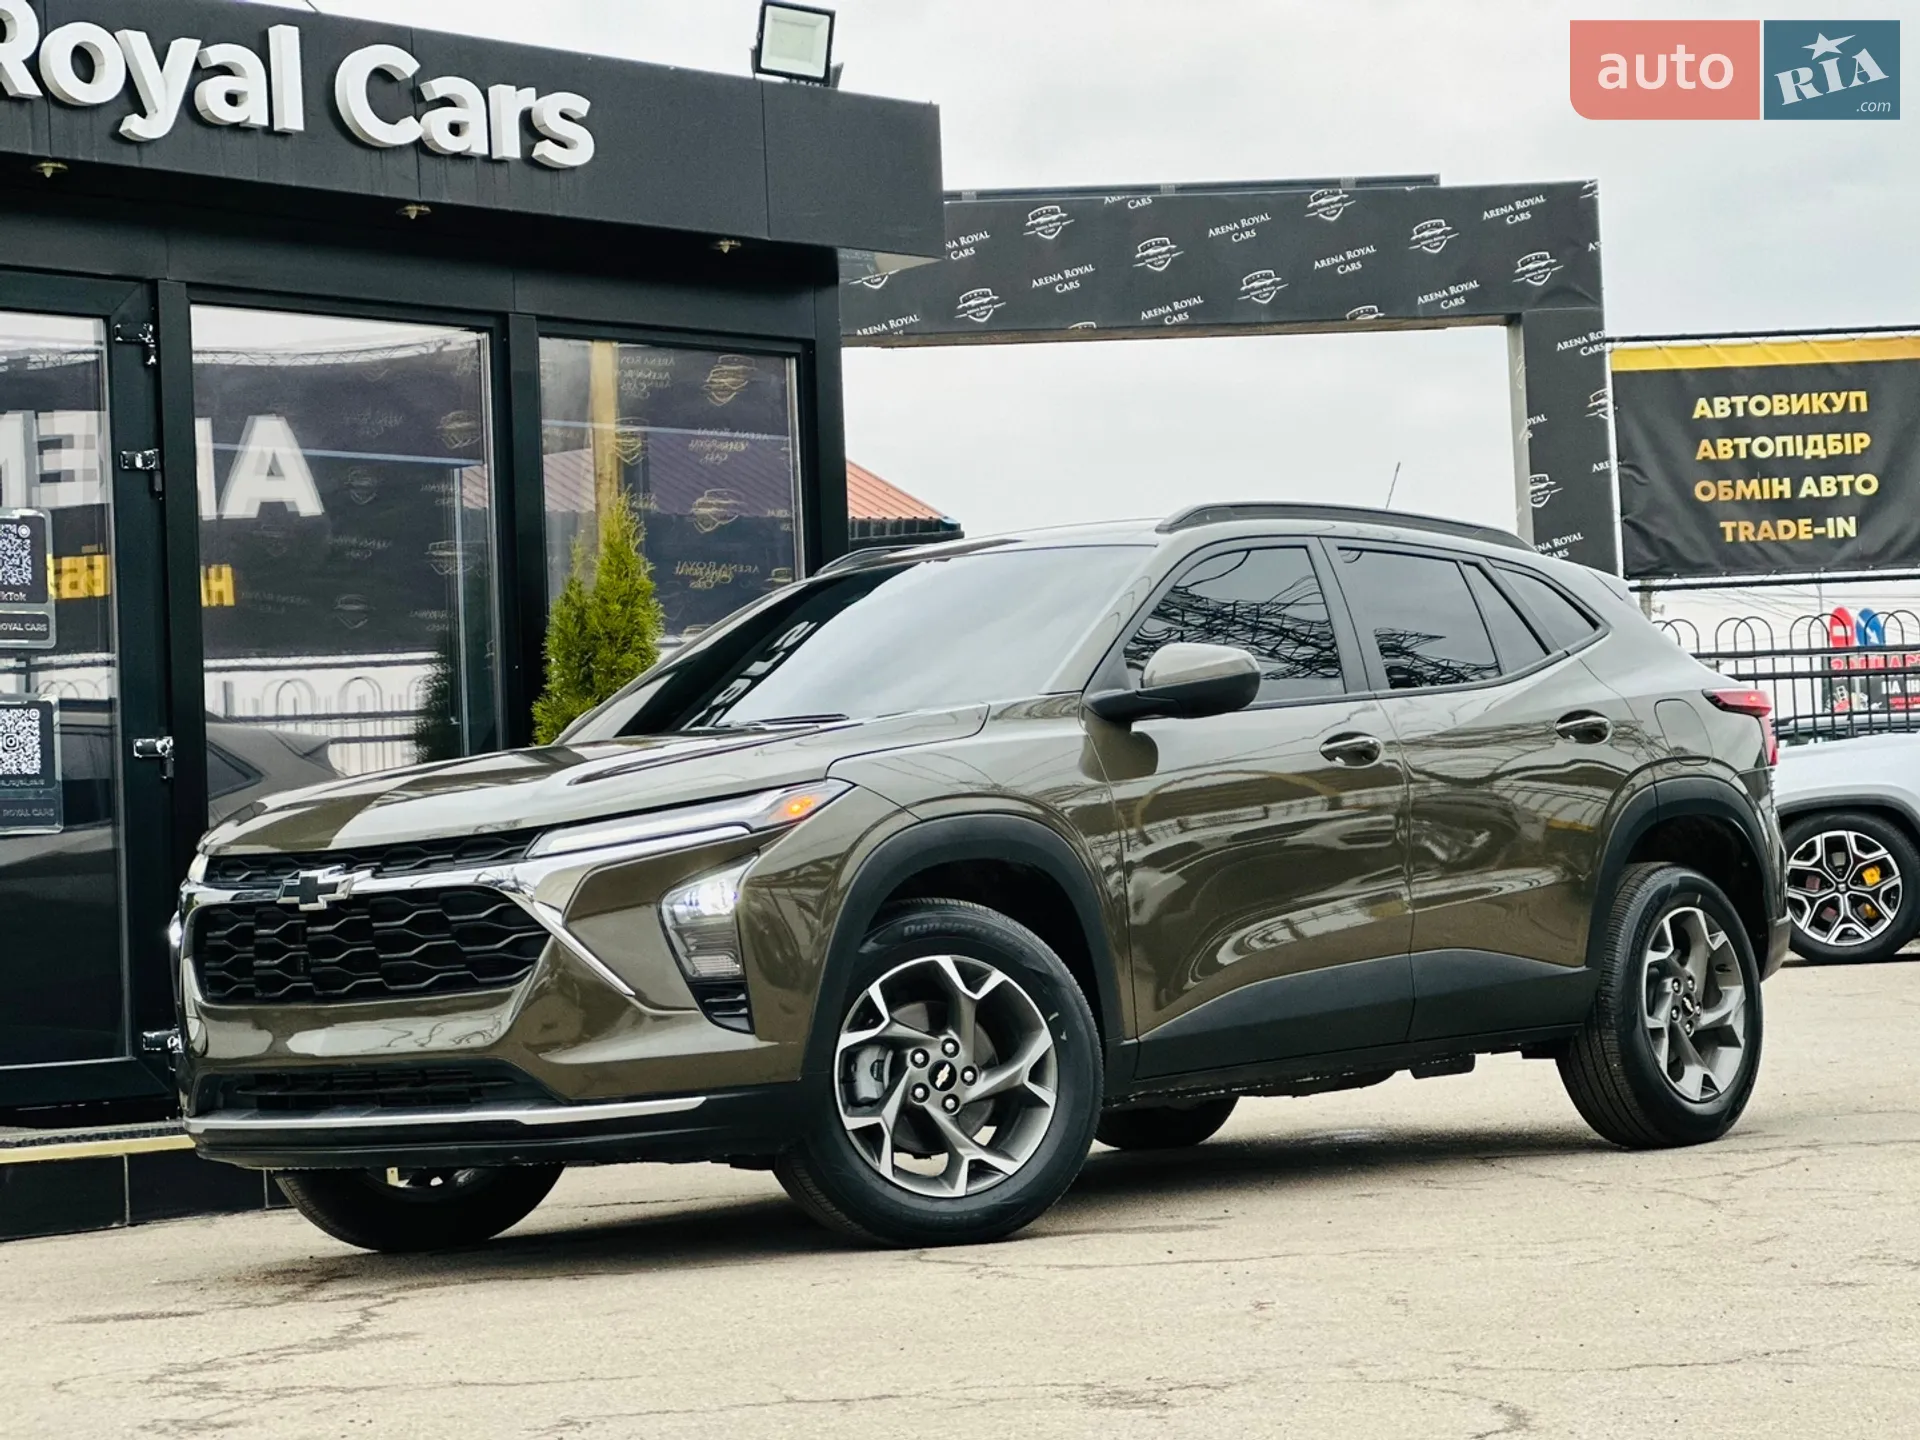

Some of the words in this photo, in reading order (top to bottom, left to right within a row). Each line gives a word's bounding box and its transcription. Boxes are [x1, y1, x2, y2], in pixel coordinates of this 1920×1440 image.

[335, 44, 595, 169] Cars
[1127, 196, 1153, 210] CARS
[1481, 204, 1515, 221] ARENA
[1515, 194, 1547, 211] ROYAL
[1207, 222, 1240, 238] ARENA
[1240, 212, 1272, 228] ROYAL
[1505, 210, 1532, 225] CARS
[959, 230, 991, 247] ROYAL
[1231, 229, 1257, 243] CARS
[950, 246, 976, 261] CARS
[1313, 255, 1346, 271] ARENA
[1346, 244, 1377, 260] ROYAL
[1031, 273, 1064, 289] ARENA
[1064, 263, 1096, 279] ROYAL
[1336, 260, 1363, 275] CARS
[1054, 279, 1081, 293] CARS
[1416, 289, 1449, 305] ARENA
[1449, 279, 1481, 295] ROYAL
[1140, 305, 1173, 321] ARENA
[1172, 295, 1204, 311] ROYAL
[1440, 295, 1466, 310] CARS
[856, 322, 888, 336] ARENA
[888, 314, 920, 329] ROYAL
[1163, 311, 1190, 326] CARS
[1556, 335, 1588, 352] ARENA
[1692, 390, 1868, 419] АВТОВИКУП
[1695, 432, 1872, 460] АВТОПІДБІР
[1694, 476, 1791, 502] ОБМІН
[1798, 473, 1879, 498] АВТО
[1552, 532, 1584, 547] ROYAL
[1719, 516, 1857, 542] TRADE-IN
